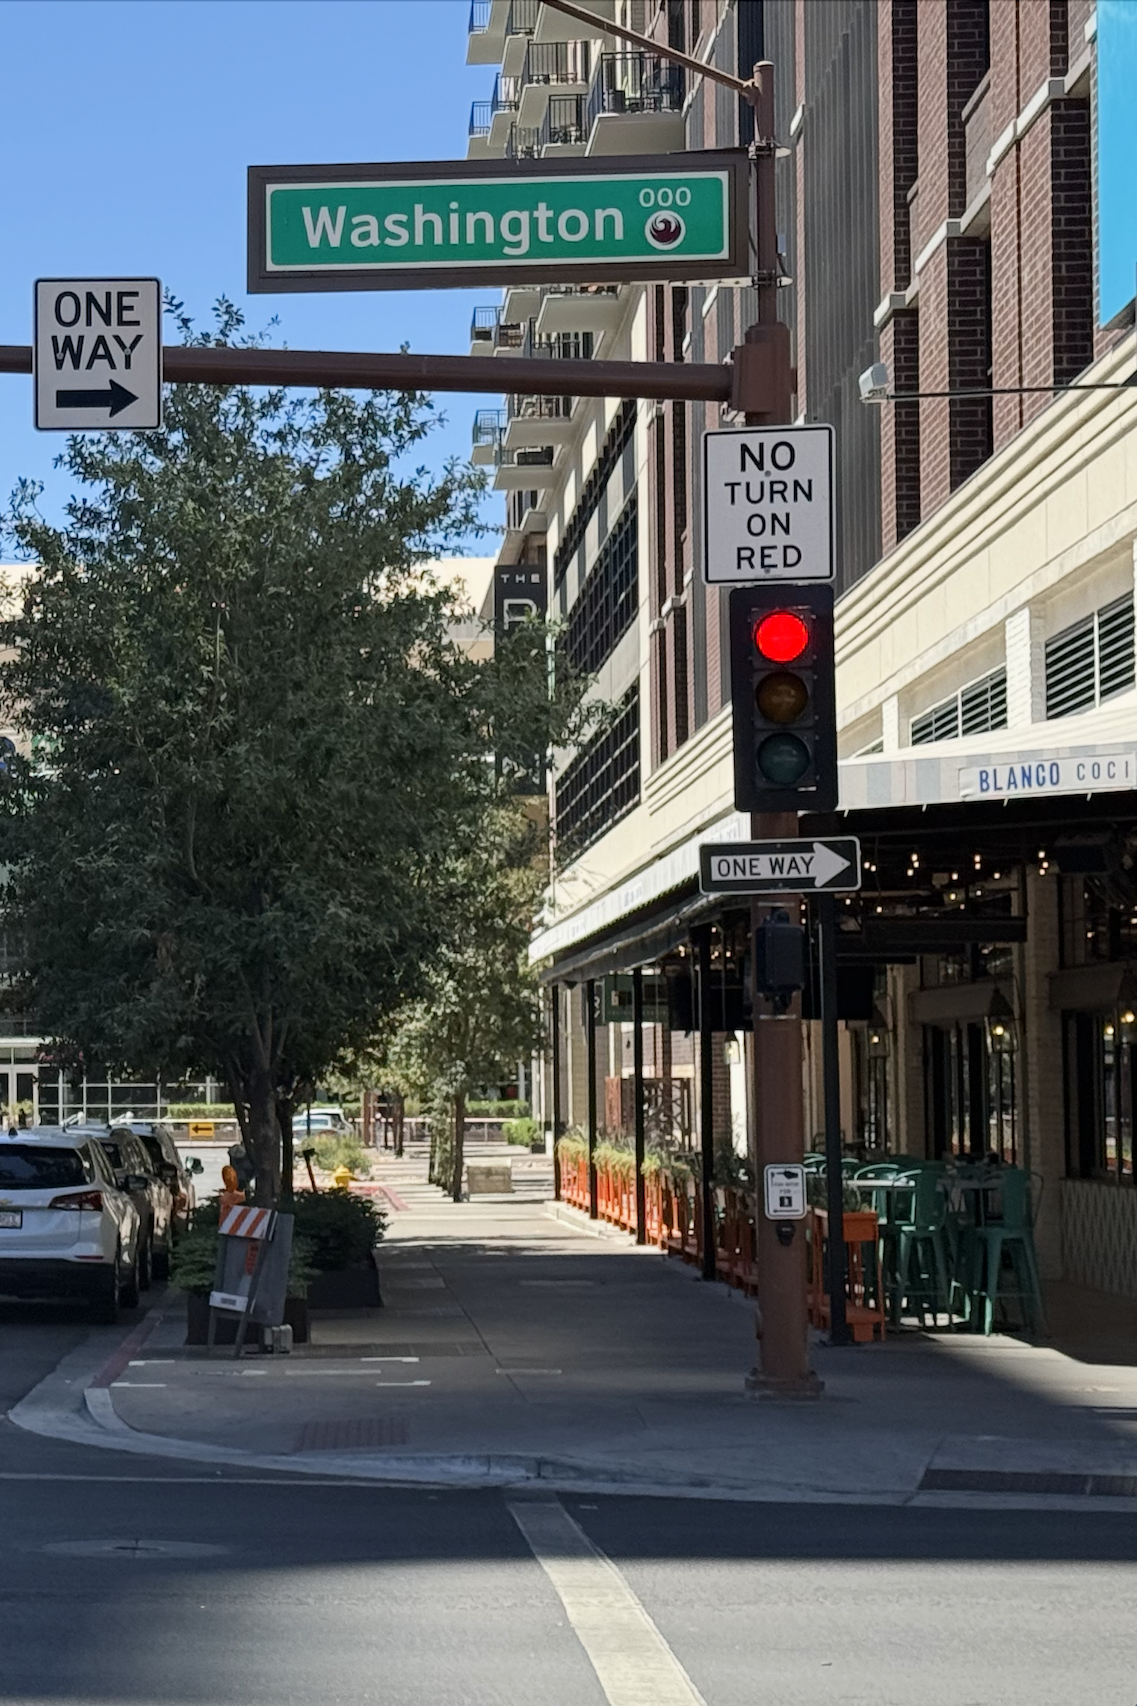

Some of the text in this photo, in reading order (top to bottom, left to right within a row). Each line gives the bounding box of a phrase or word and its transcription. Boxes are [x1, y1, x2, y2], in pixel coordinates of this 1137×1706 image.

[302, 201, 624, 256] Washington
[54, 291, 141, 327] ONE
[51, 335, 144, 370] WAY
[740, 441, 795, 472] NO
[724, 479, 813, 505] TURN
[747, 512, 790, 537] ON
[736, 545, 802, 570] RED
[500, 573, 540, 584] THE
[979, 760, 1129, 792] BLANCO COCI
[717, 855, 815, 877] ONE WAY
